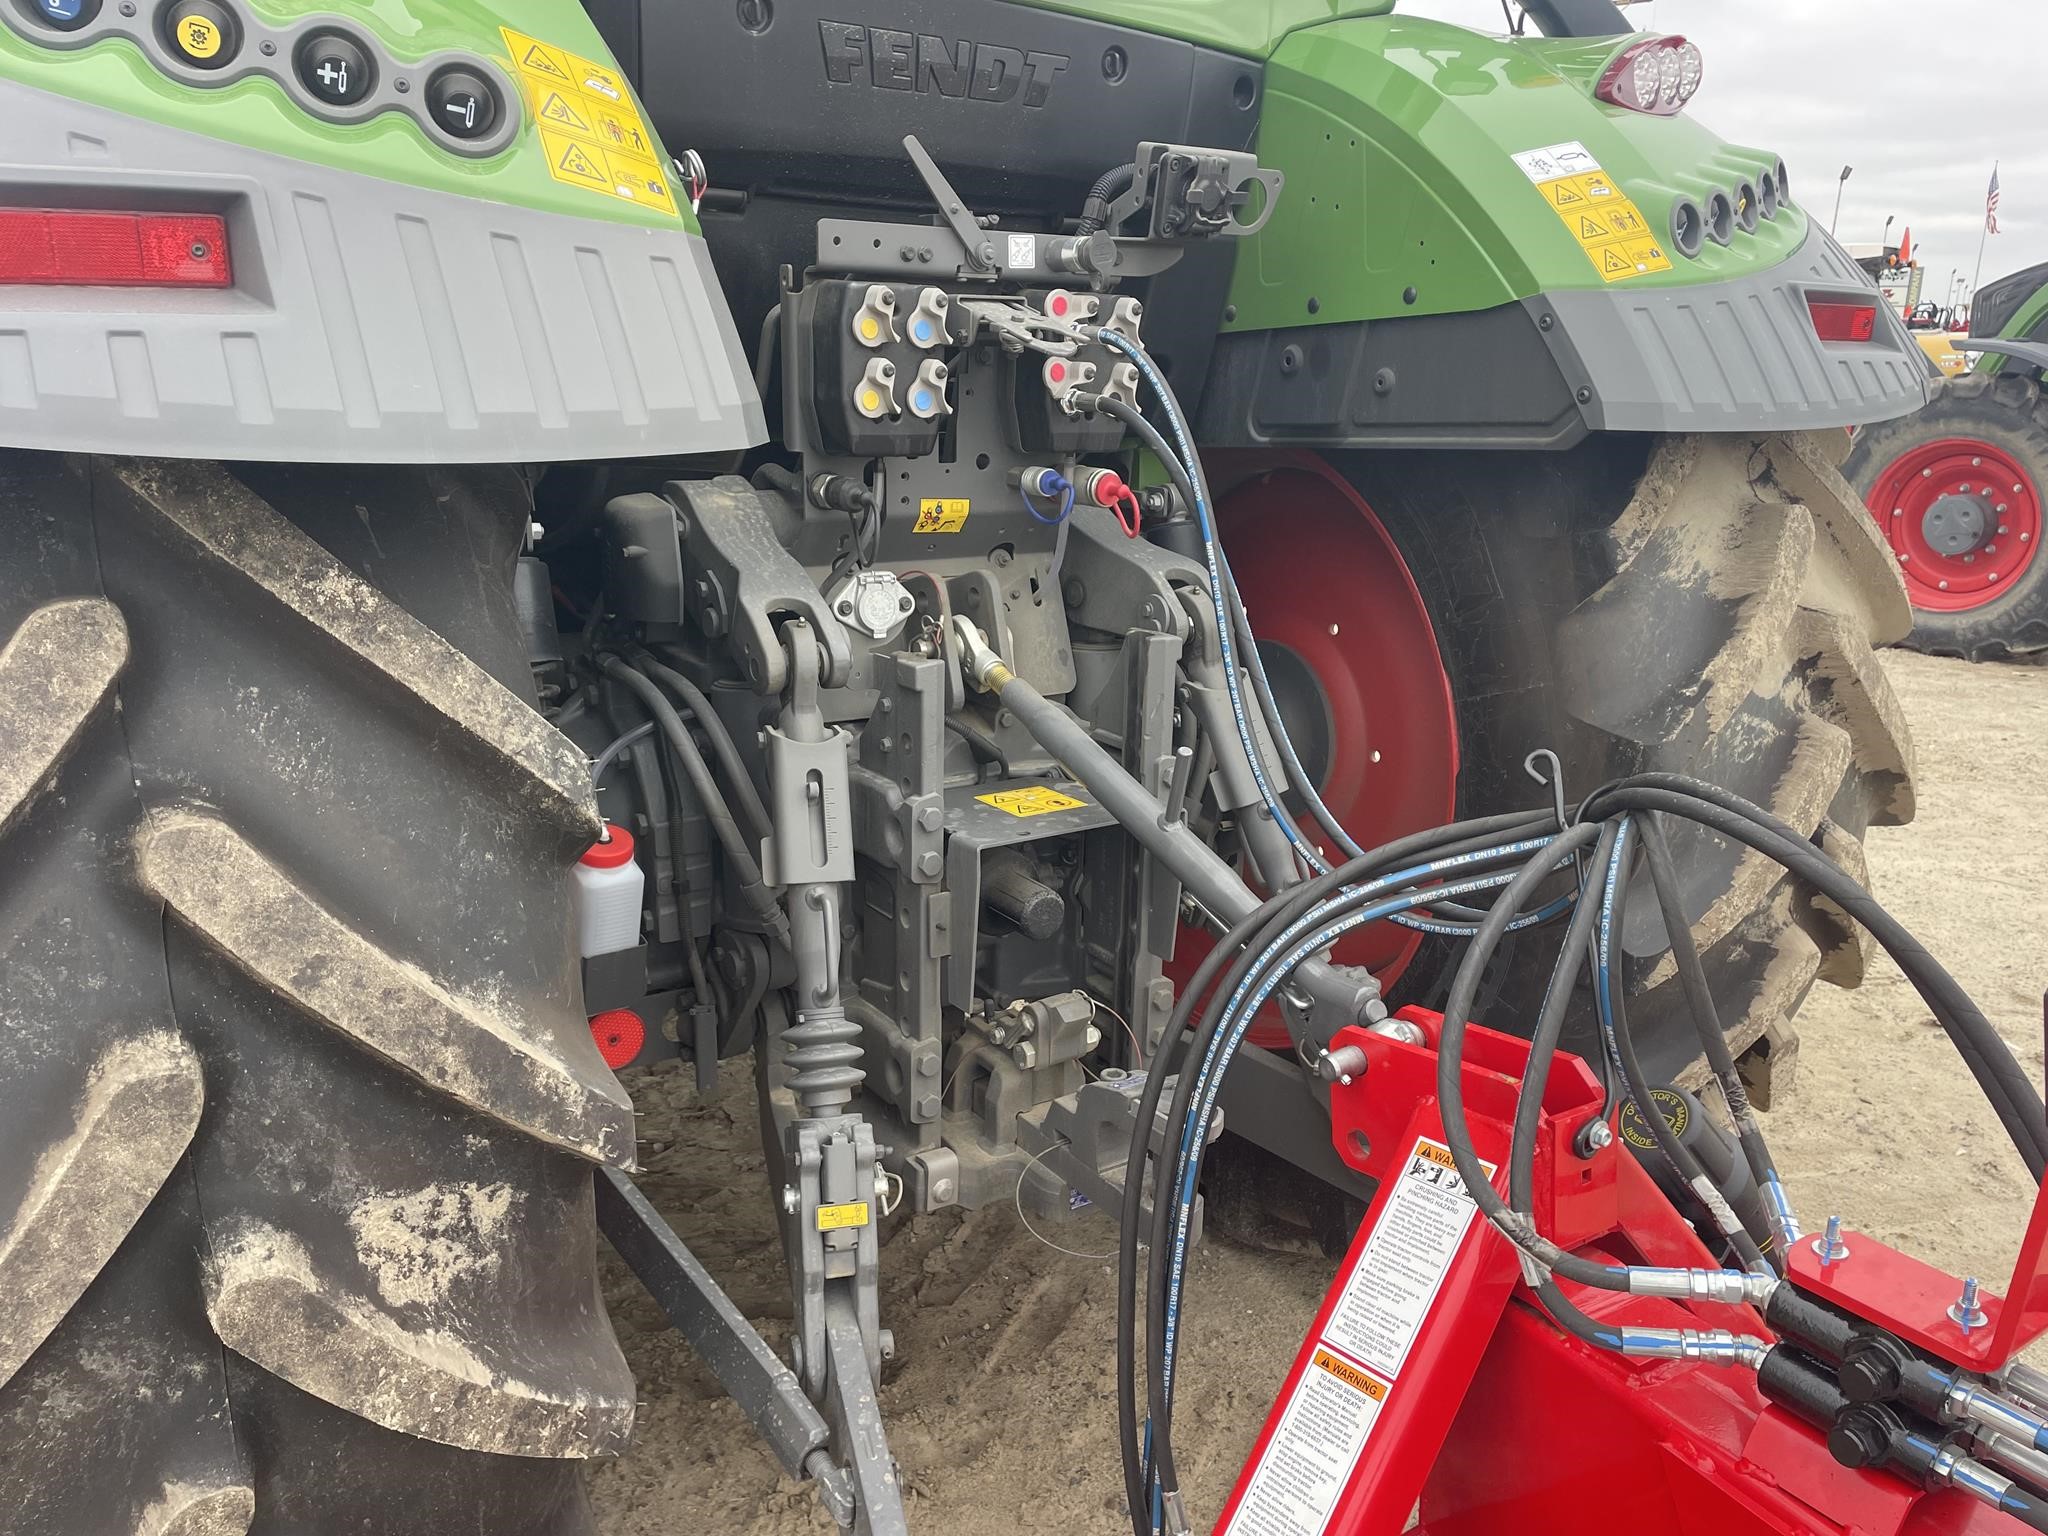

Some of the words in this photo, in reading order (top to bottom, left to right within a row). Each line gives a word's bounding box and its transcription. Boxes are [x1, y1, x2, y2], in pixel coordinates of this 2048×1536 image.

[817, 18, 1071, 110] FENDT
[1205, 541, 1218, 578] MNFLEX
[1211, 578, 1222, 600] DN10
[1214, 600, 1226, 617] SAE
[1217, 618, 1229, 647] 100R17
[1226, 665, 1235, 676] ID
[1227, 674, 1238, 689] WP
[1231, 689, 1241, 703] 207
[1234, 702, 1245, 718] BAR
[1249, 754, 1263, 776] MSHA
[1294, 840, 1320, 870] MNFLEX
[1430, 856, 1472, 871] MNFLEX
[1474, 850, 1497, 861] DN10
[1499, 845, 1518, 855] SAE
[1519, 838, 1549, 851] 100R17
[1410, 891, 1446, 905] IC-256/09
[1448, 883, 1475, 896] MSHA
[1602, 883, 1617, 917] MSHA
[1326, 913, 1365, 938] MNFLEX
[1397, 914, 1407, 925] ID
[1406, 918, 1421, 931] WP
[1421, 923, 1434, 932] 207
[1434, 925, 1452, 935] BAR
[1303, 932, 1325, 952] DN10
[1287, 949, 1305, 966] SAE
[1265, 962, 1289, 991] 100R17
[1191, 1074, 1207, 1111] MNFLEX
[1202, 1052, 1215, 1074] DN10
[1211, 1033, 1222, 1053] SAE
[1217, 1005, 1235, 1033] 100R17
[1242, 975, 1253, 986] ID
[1250, 960, 1263, 978] WP
[1260, 946, 1276, 965] 207
[1271, 934, 1290, 952] BAR
[1322, 893, 1348, 914] MSHA
[1244, 1009, 1255, 1020] ID
[1237, 1018, 1250, 1034] WP
[1230, 1033, 1241, 1048] 207
[1221, 1046, 1236, 1066] BAR
[1200, 1103, 1213, 1129] MSHA
[1672, 1106, 1687, 1137] MANUA
[1190, 1128, 1205, 1162] IC-256/09
[1625, 1126, 1653, 1147] INSIDE
[1407, 1188, 1435, 1205] PINCHING
[1435, 1201, 1460, 1216] HAZARD
[1415, 1184, 1445, 1201] CRUSHING
[1444, 1197, 1459, 1207] AND
[1177, 1203, 1190, 1241] MNFLEX
[1174, 1241, 1186, 1263] DN10
[1172, 1262, 1182, 1280] SAE
[1168, 1282, 1179, 1312] 100R17
[1166, 1331, 1175, 1341] ID
[1340, 1312, 1360, 1327] FAILURE
[1366, 1326, 1387, 1341] FOLLOW
[1386, 1337, 1402, 1349] THESE
[1343, 1322, 1376, 1343] INSTRUCTIONS
[1375, 1339, 1393, 1352] COULD
[1164, 1340, 1174, 1356] WP
[1336, 1325, 1354, 1337] RESULT
[1358, 1337, 1379, 1352] SERIOUS
[1378, 1348, 1395, 1361] INJURY
[1163, 1356, 1172, 1370] 207
[1162, 1370, 1171, 1389] BAR
[1316, 1380, 1336, 1395] INJURY
[1333, 1365, 1378, 1395] WARNING
[1327, 1378, 1344, 1392] AVOID
[1343, 1388, 1367, 1405] SERIOUS
